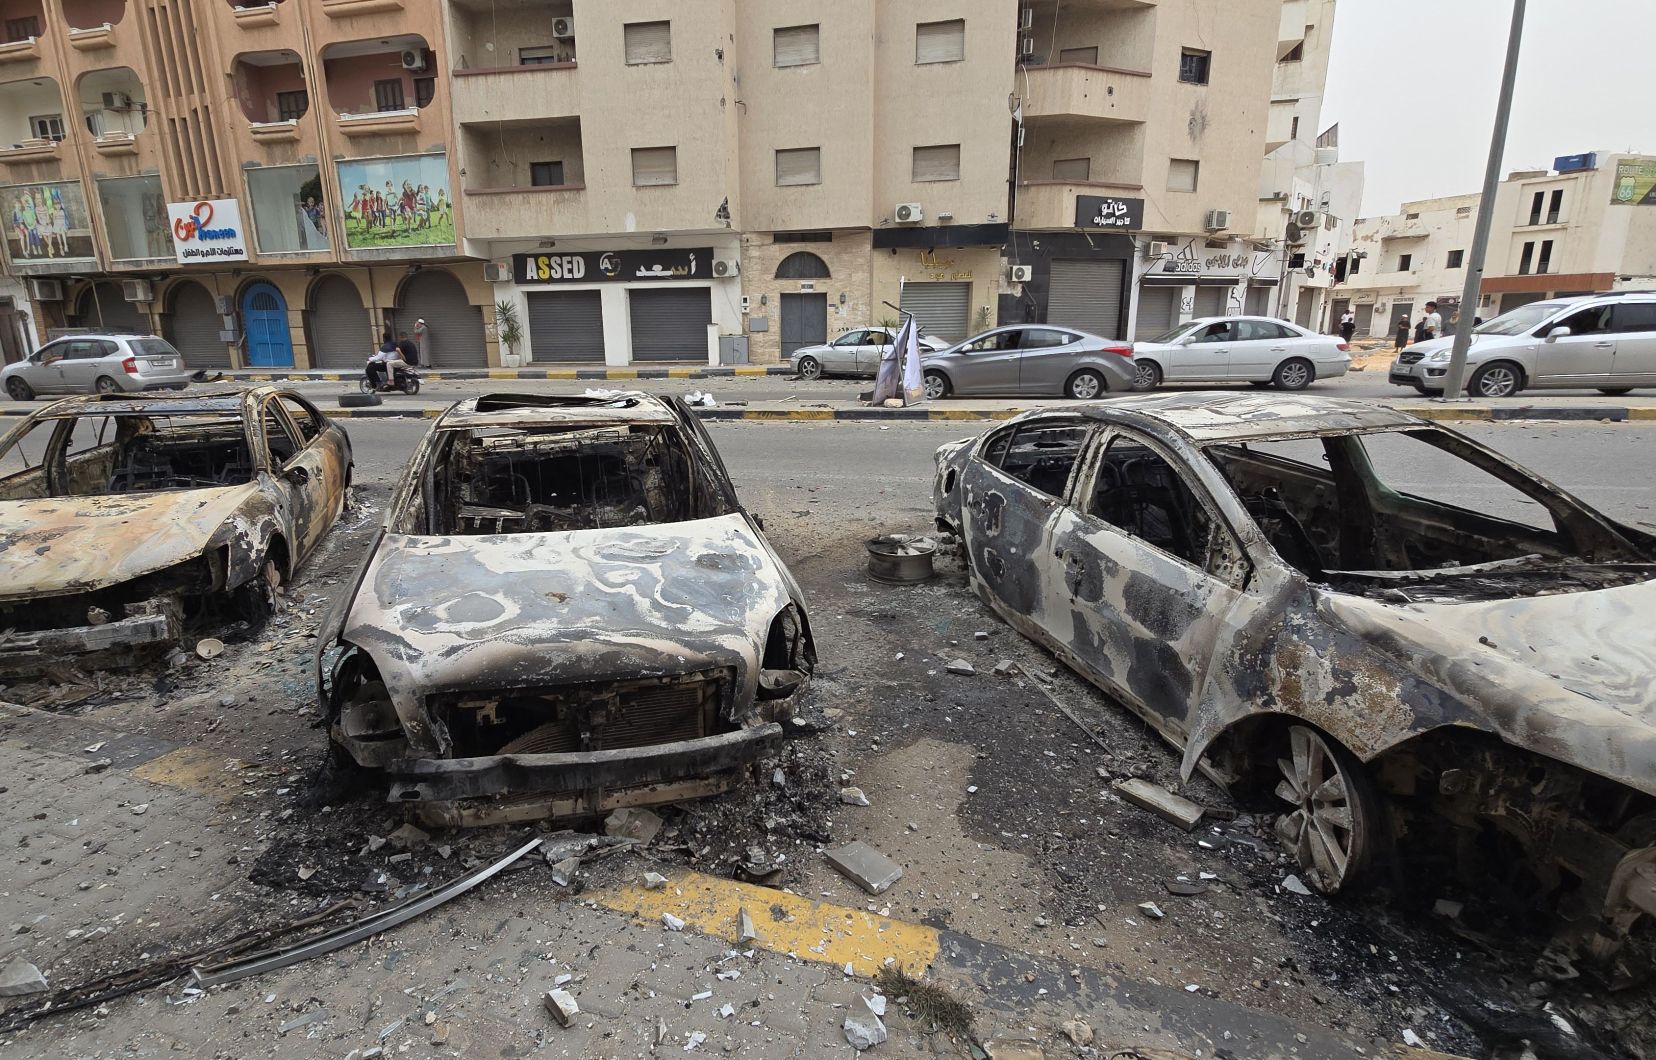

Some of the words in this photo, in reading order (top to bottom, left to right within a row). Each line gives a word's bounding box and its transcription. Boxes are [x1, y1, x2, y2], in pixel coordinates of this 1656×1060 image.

[1618, 165, 1644, 175] ROUTE
[1619, 186, 1632, 198] 66
[182, 248, 201, 258] الطفل
[217, 246, 244, 256] مستلزمات
[526, 255, 586, 280] ASSED
[635, 252, 697, 277] أسعد
